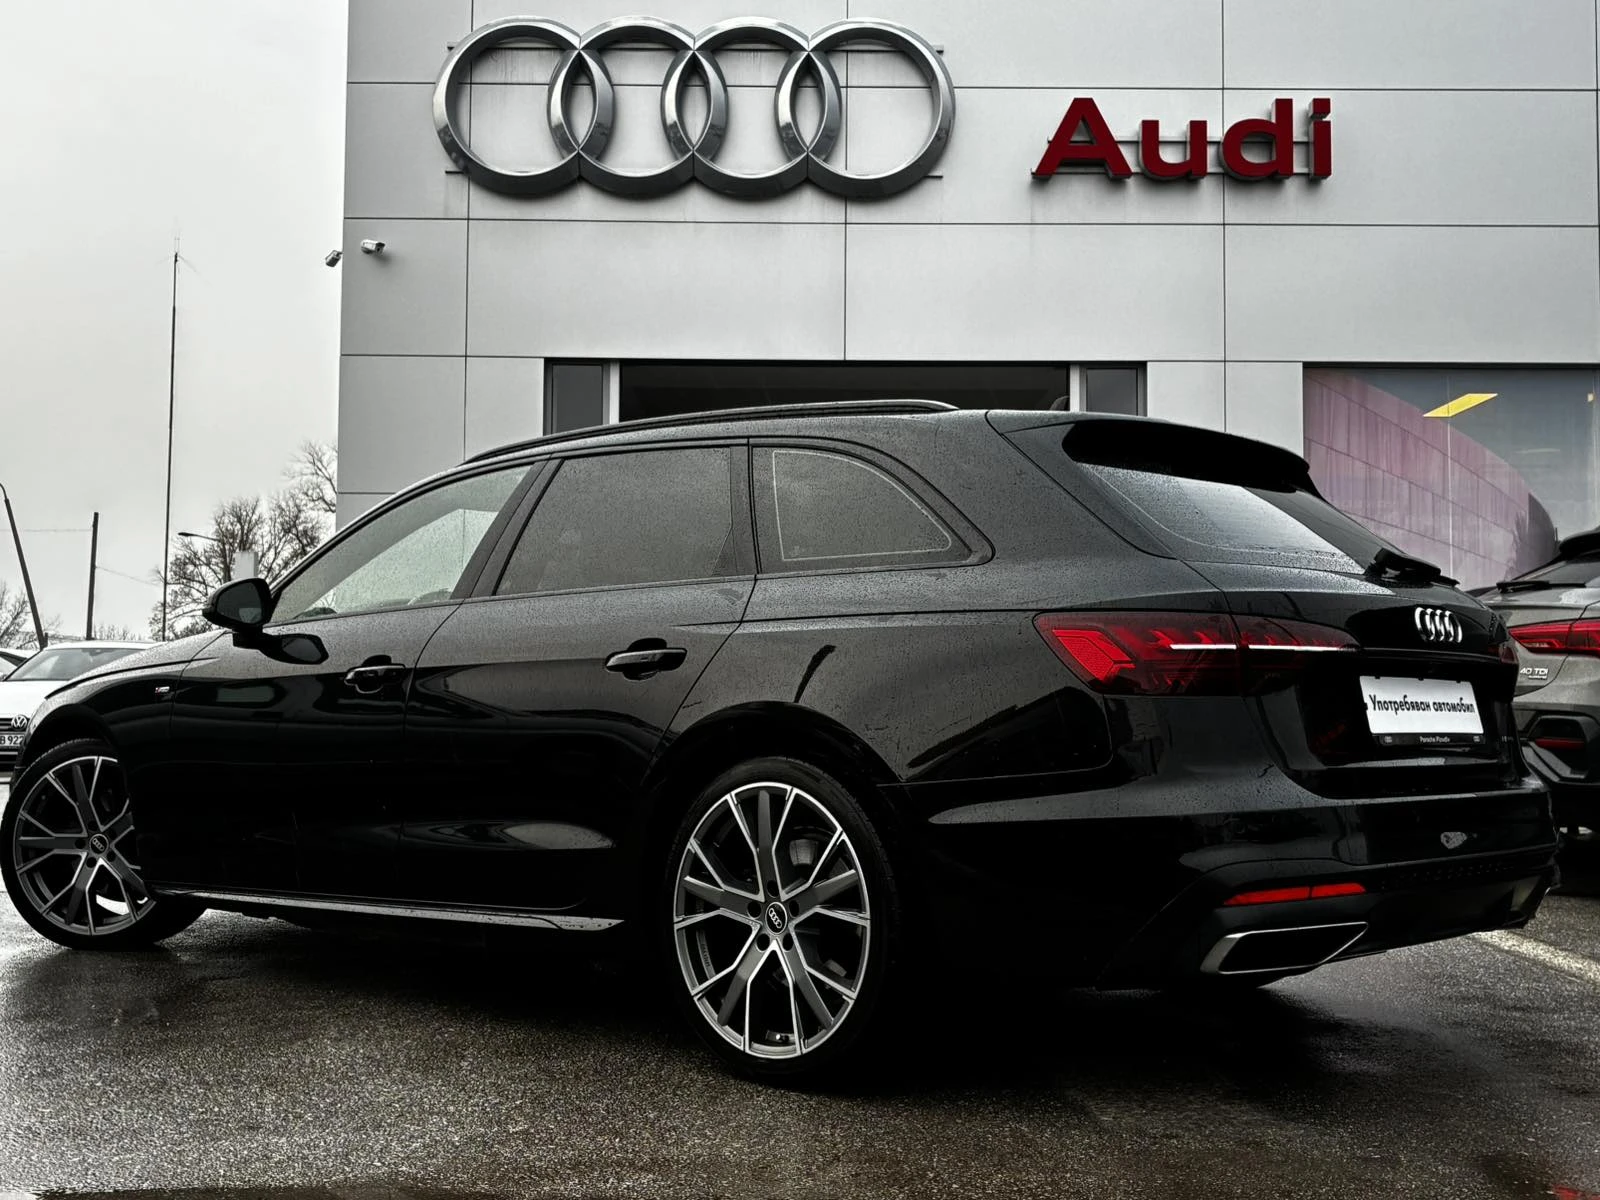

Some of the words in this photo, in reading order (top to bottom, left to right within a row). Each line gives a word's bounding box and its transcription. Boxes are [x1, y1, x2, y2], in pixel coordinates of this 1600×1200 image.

[1031, 97, 1332, 181] Audi
[1368, 694, 1432, 715] Употребяван
[1432, 697, 1476, 713] автомобил
